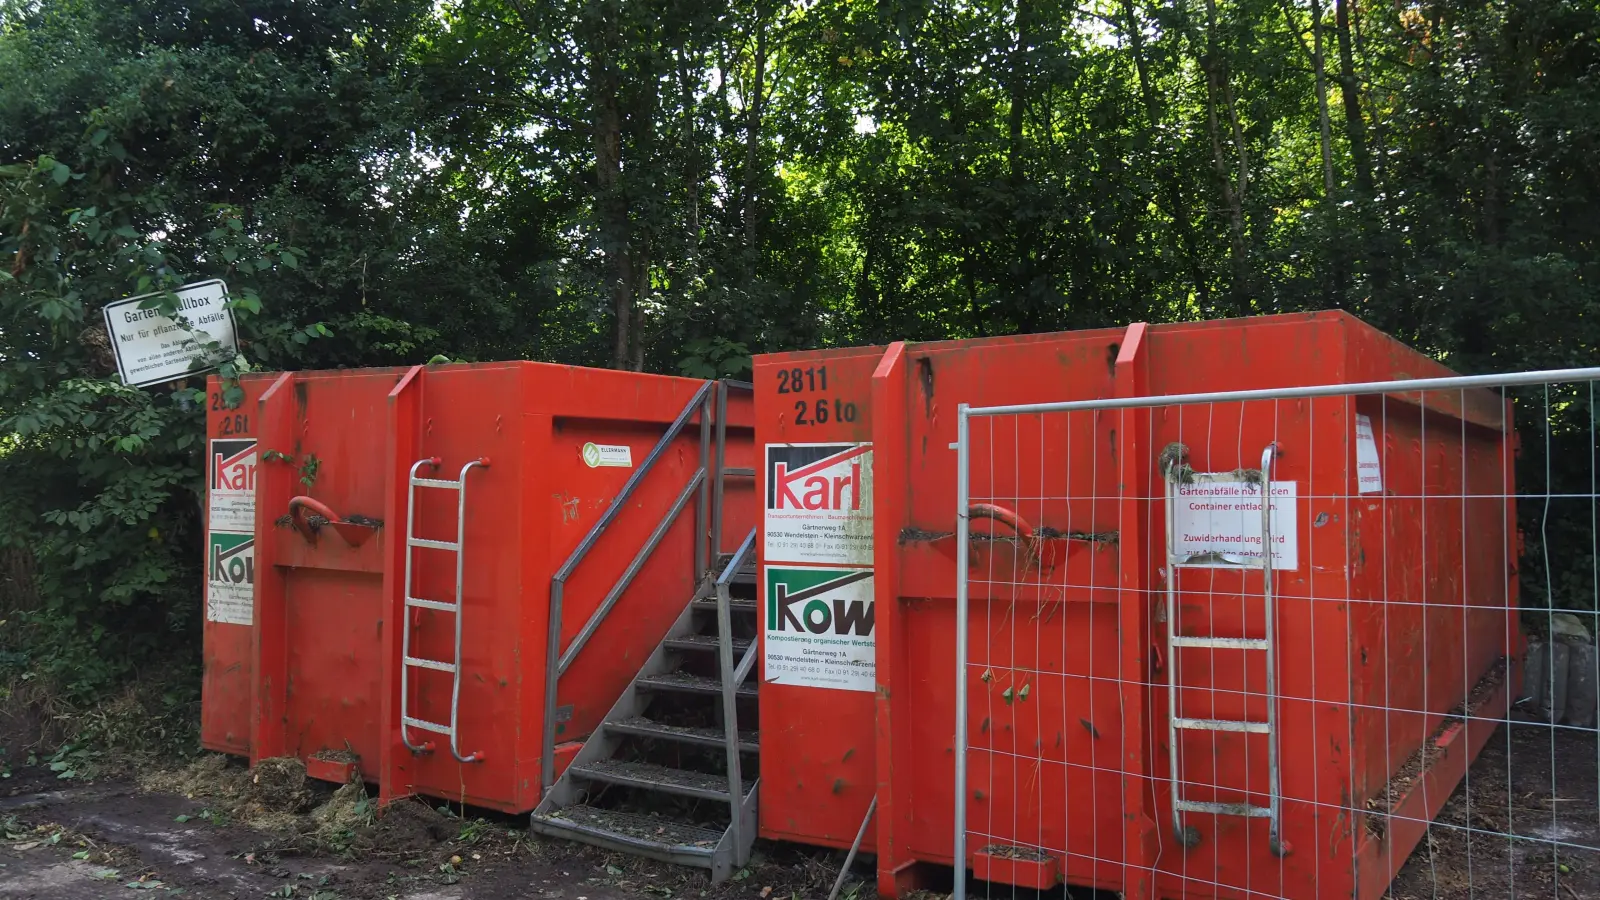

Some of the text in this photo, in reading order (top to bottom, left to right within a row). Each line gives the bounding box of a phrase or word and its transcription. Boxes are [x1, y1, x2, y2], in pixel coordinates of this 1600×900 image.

[120, 333, 134, 343] Nur
[138, 328, 149, 339] für
[198, 312, 225, 326] Abfälle
[163, 348, 184, 358] anderen
[130, 362, 164, 375] gewerblichen
[777, 366, 827, 394] 2811
[795, 398, 857, 426] 2,6 to
[776, 463, 861, 510] Karl
[1180, 487, 1239, 496] Gartenabfälle
[1189, 502, 1278, 510] Container entladn.
[802, 524, 836, 532] Gärtnerweg
[1184, 534, 1261, 544] Zuwiderhandlung
[767, 634, 812, 644] Kompostierung
[814, 638, 850, 646] organischer
[802, 648, 837, 658] Gärtnerweg
[784, 656, 820, 664] Wendelstein
